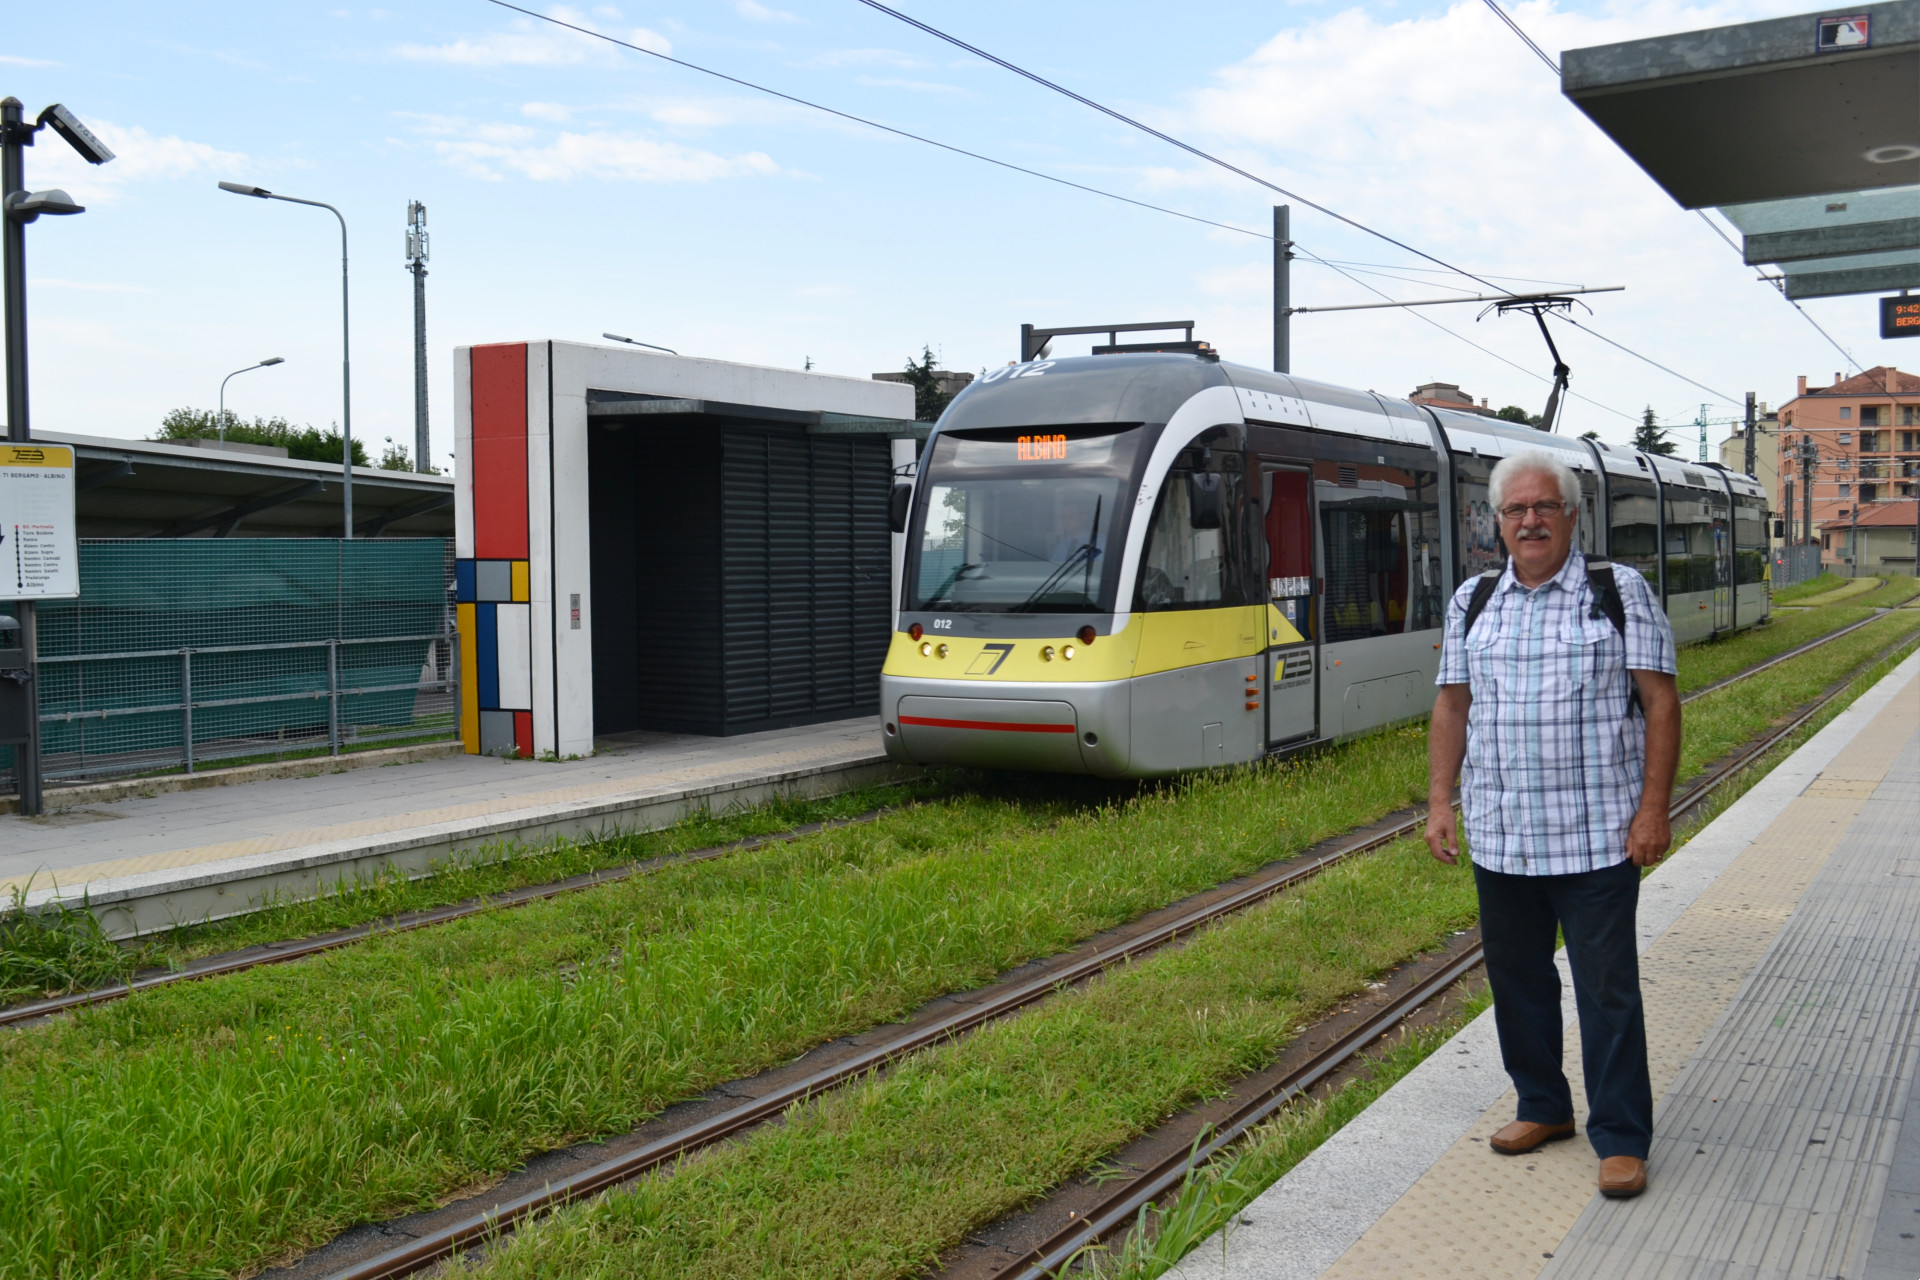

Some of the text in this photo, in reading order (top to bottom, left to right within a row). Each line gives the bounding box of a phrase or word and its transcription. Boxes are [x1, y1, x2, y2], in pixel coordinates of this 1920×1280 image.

[1896, 304, 1919, 315] 9:42
[1017, 434, 1067, 461] ALBINO
[933, 618, 952, 629] 012
